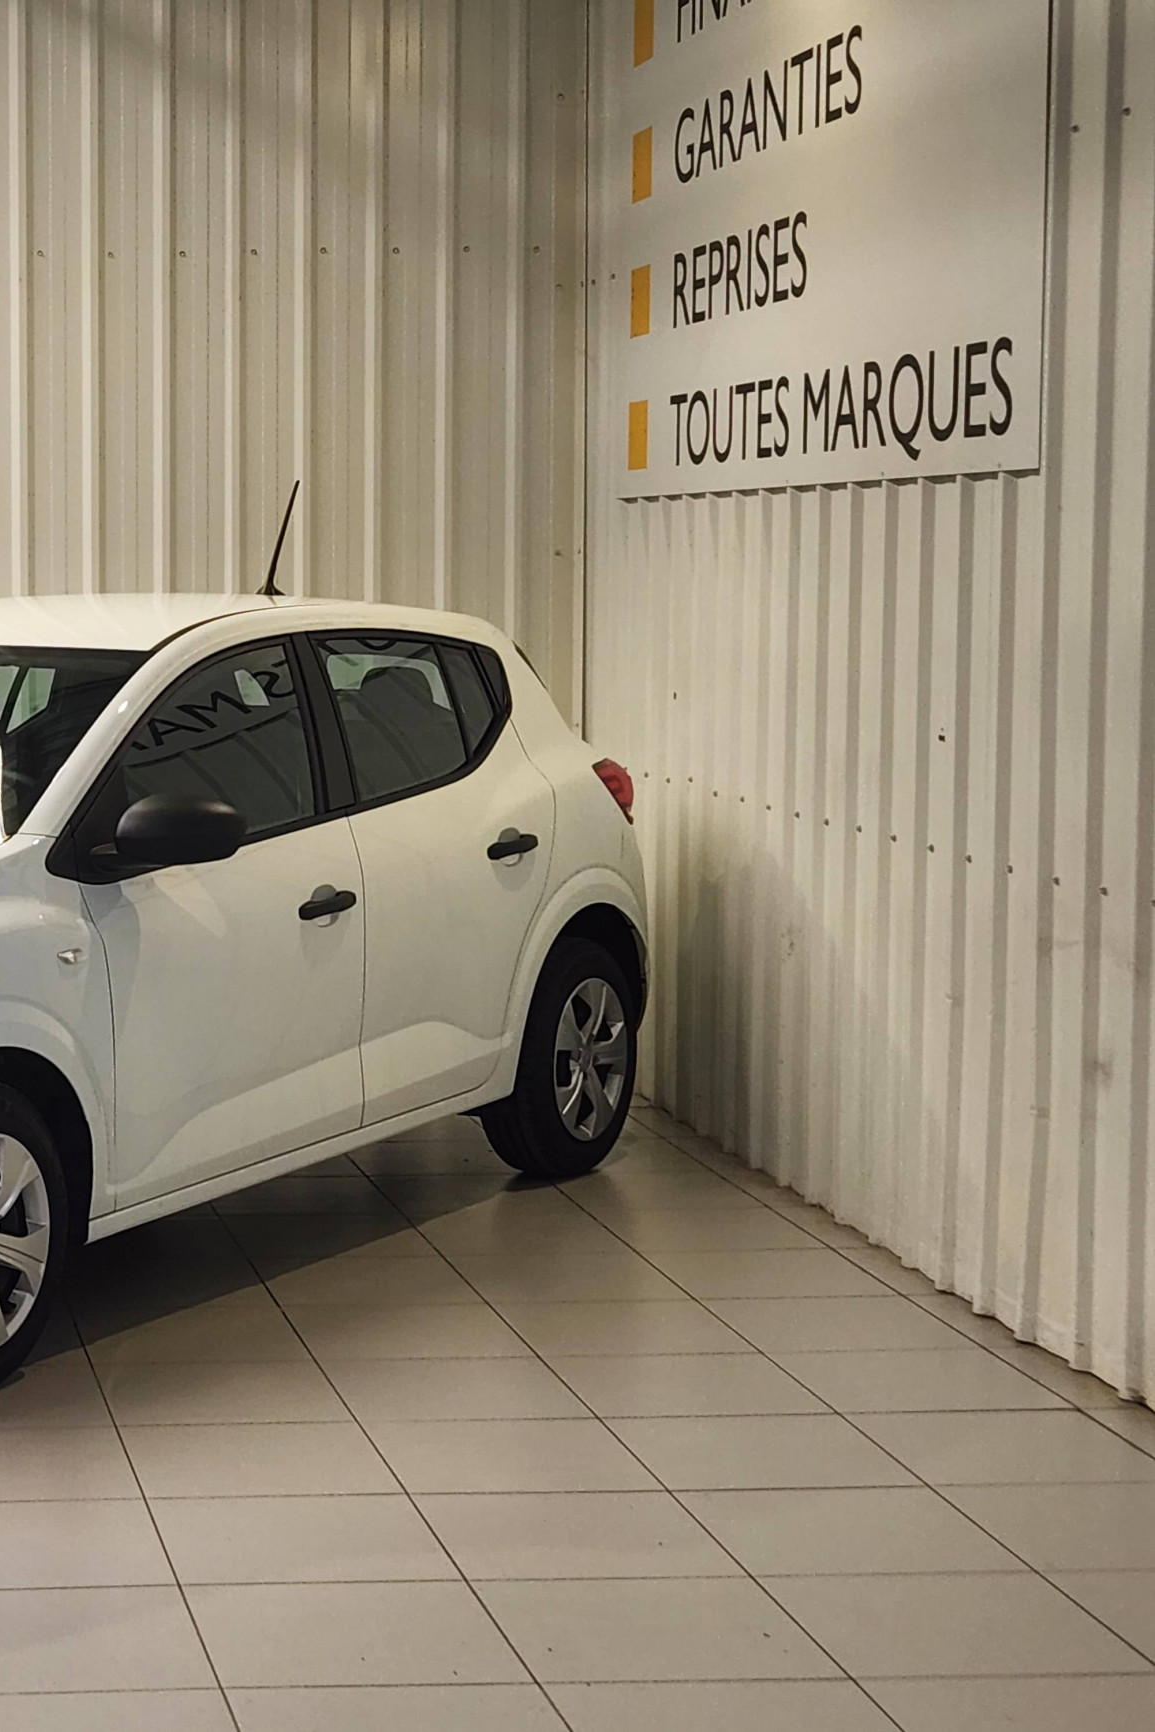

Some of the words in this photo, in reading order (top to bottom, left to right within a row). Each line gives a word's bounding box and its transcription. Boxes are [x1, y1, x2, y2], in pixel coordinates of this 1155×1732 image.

[674, 25, 862, 183] GARANTIES
[674, 212, 806, 328] REPRISES
[670, 377, 788, 465] TOUTES
[803, 337, 1012, 460] MARQUES
